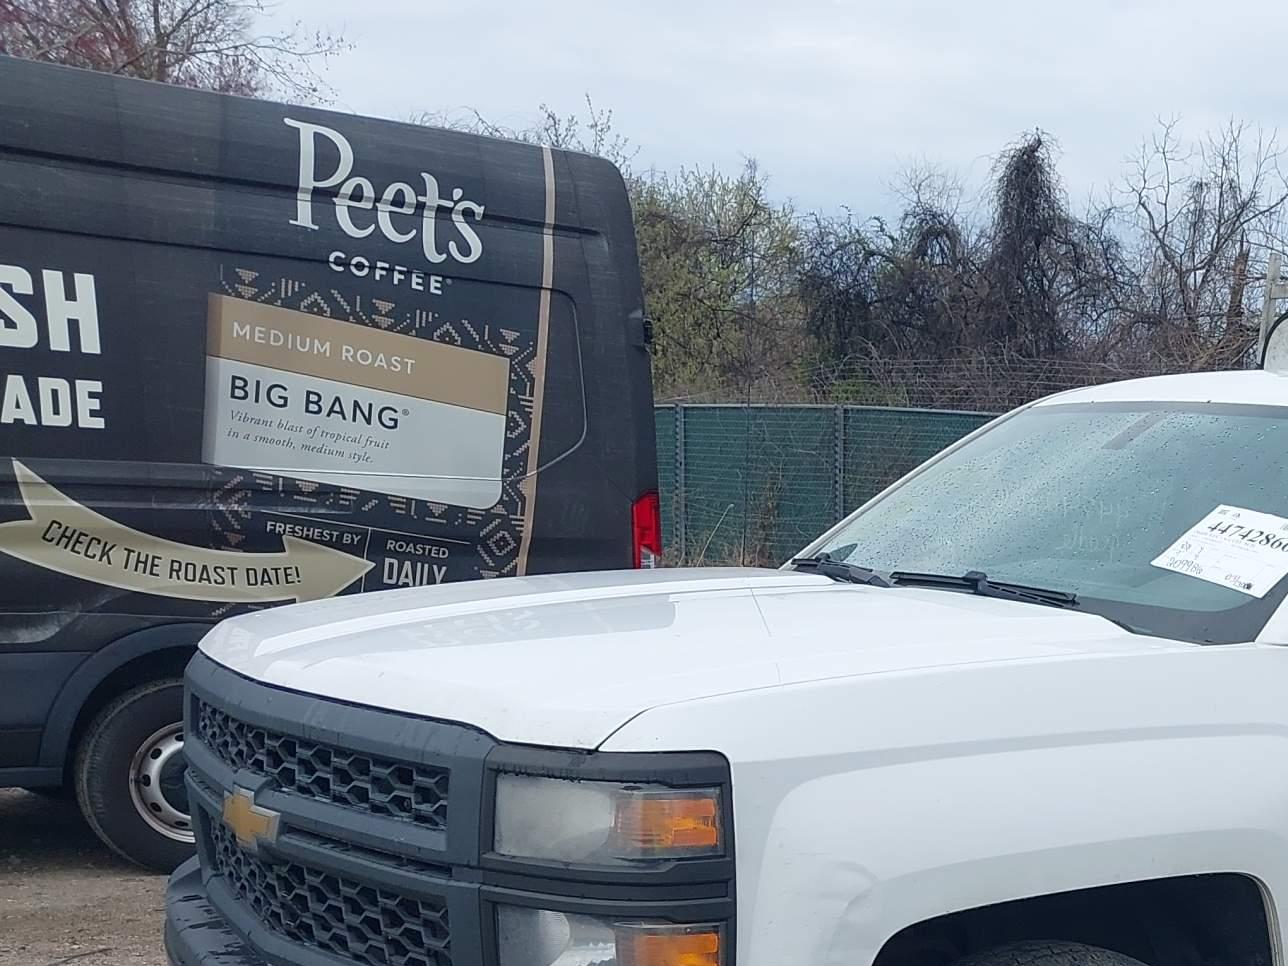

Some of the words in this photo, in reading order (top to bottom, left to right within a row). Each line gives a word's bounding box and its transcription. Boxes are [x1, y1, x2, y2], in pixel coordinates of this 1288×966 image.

[283, 117, 486, 264] Peet's
[232, 321, 331, 358] MEDIUM
[341, 344, 416, 375] ROAST
[0, 374, 106, 430] ADE
[229, 374, 289, 409] BIG
[227, 427, 239, 439] in
[243, 432, 251, 442] a
[253, 433, 297, 451] smooth,
[300, 442, 345, 459] medium
[349, 449, 374, 464] style.
[230, 409, 274, 428] Vibrant
[276, 419, 304, 434] blast
[306, 425, 320, 438] of
[320, 429, 361, 445] tropical
[363, 435, 390, 450] fruit
[41, 519, 117, 566] CHECK
[122, 547, 163, 577] THE
[168, 559, 238, 587] ROAST
[246, 566, 301, 587] DATE!
[266, 520, 340, 543] FRESHEST
[342, 532, 362, 545] BY
[386, 539, 450, 559] ROASTED
